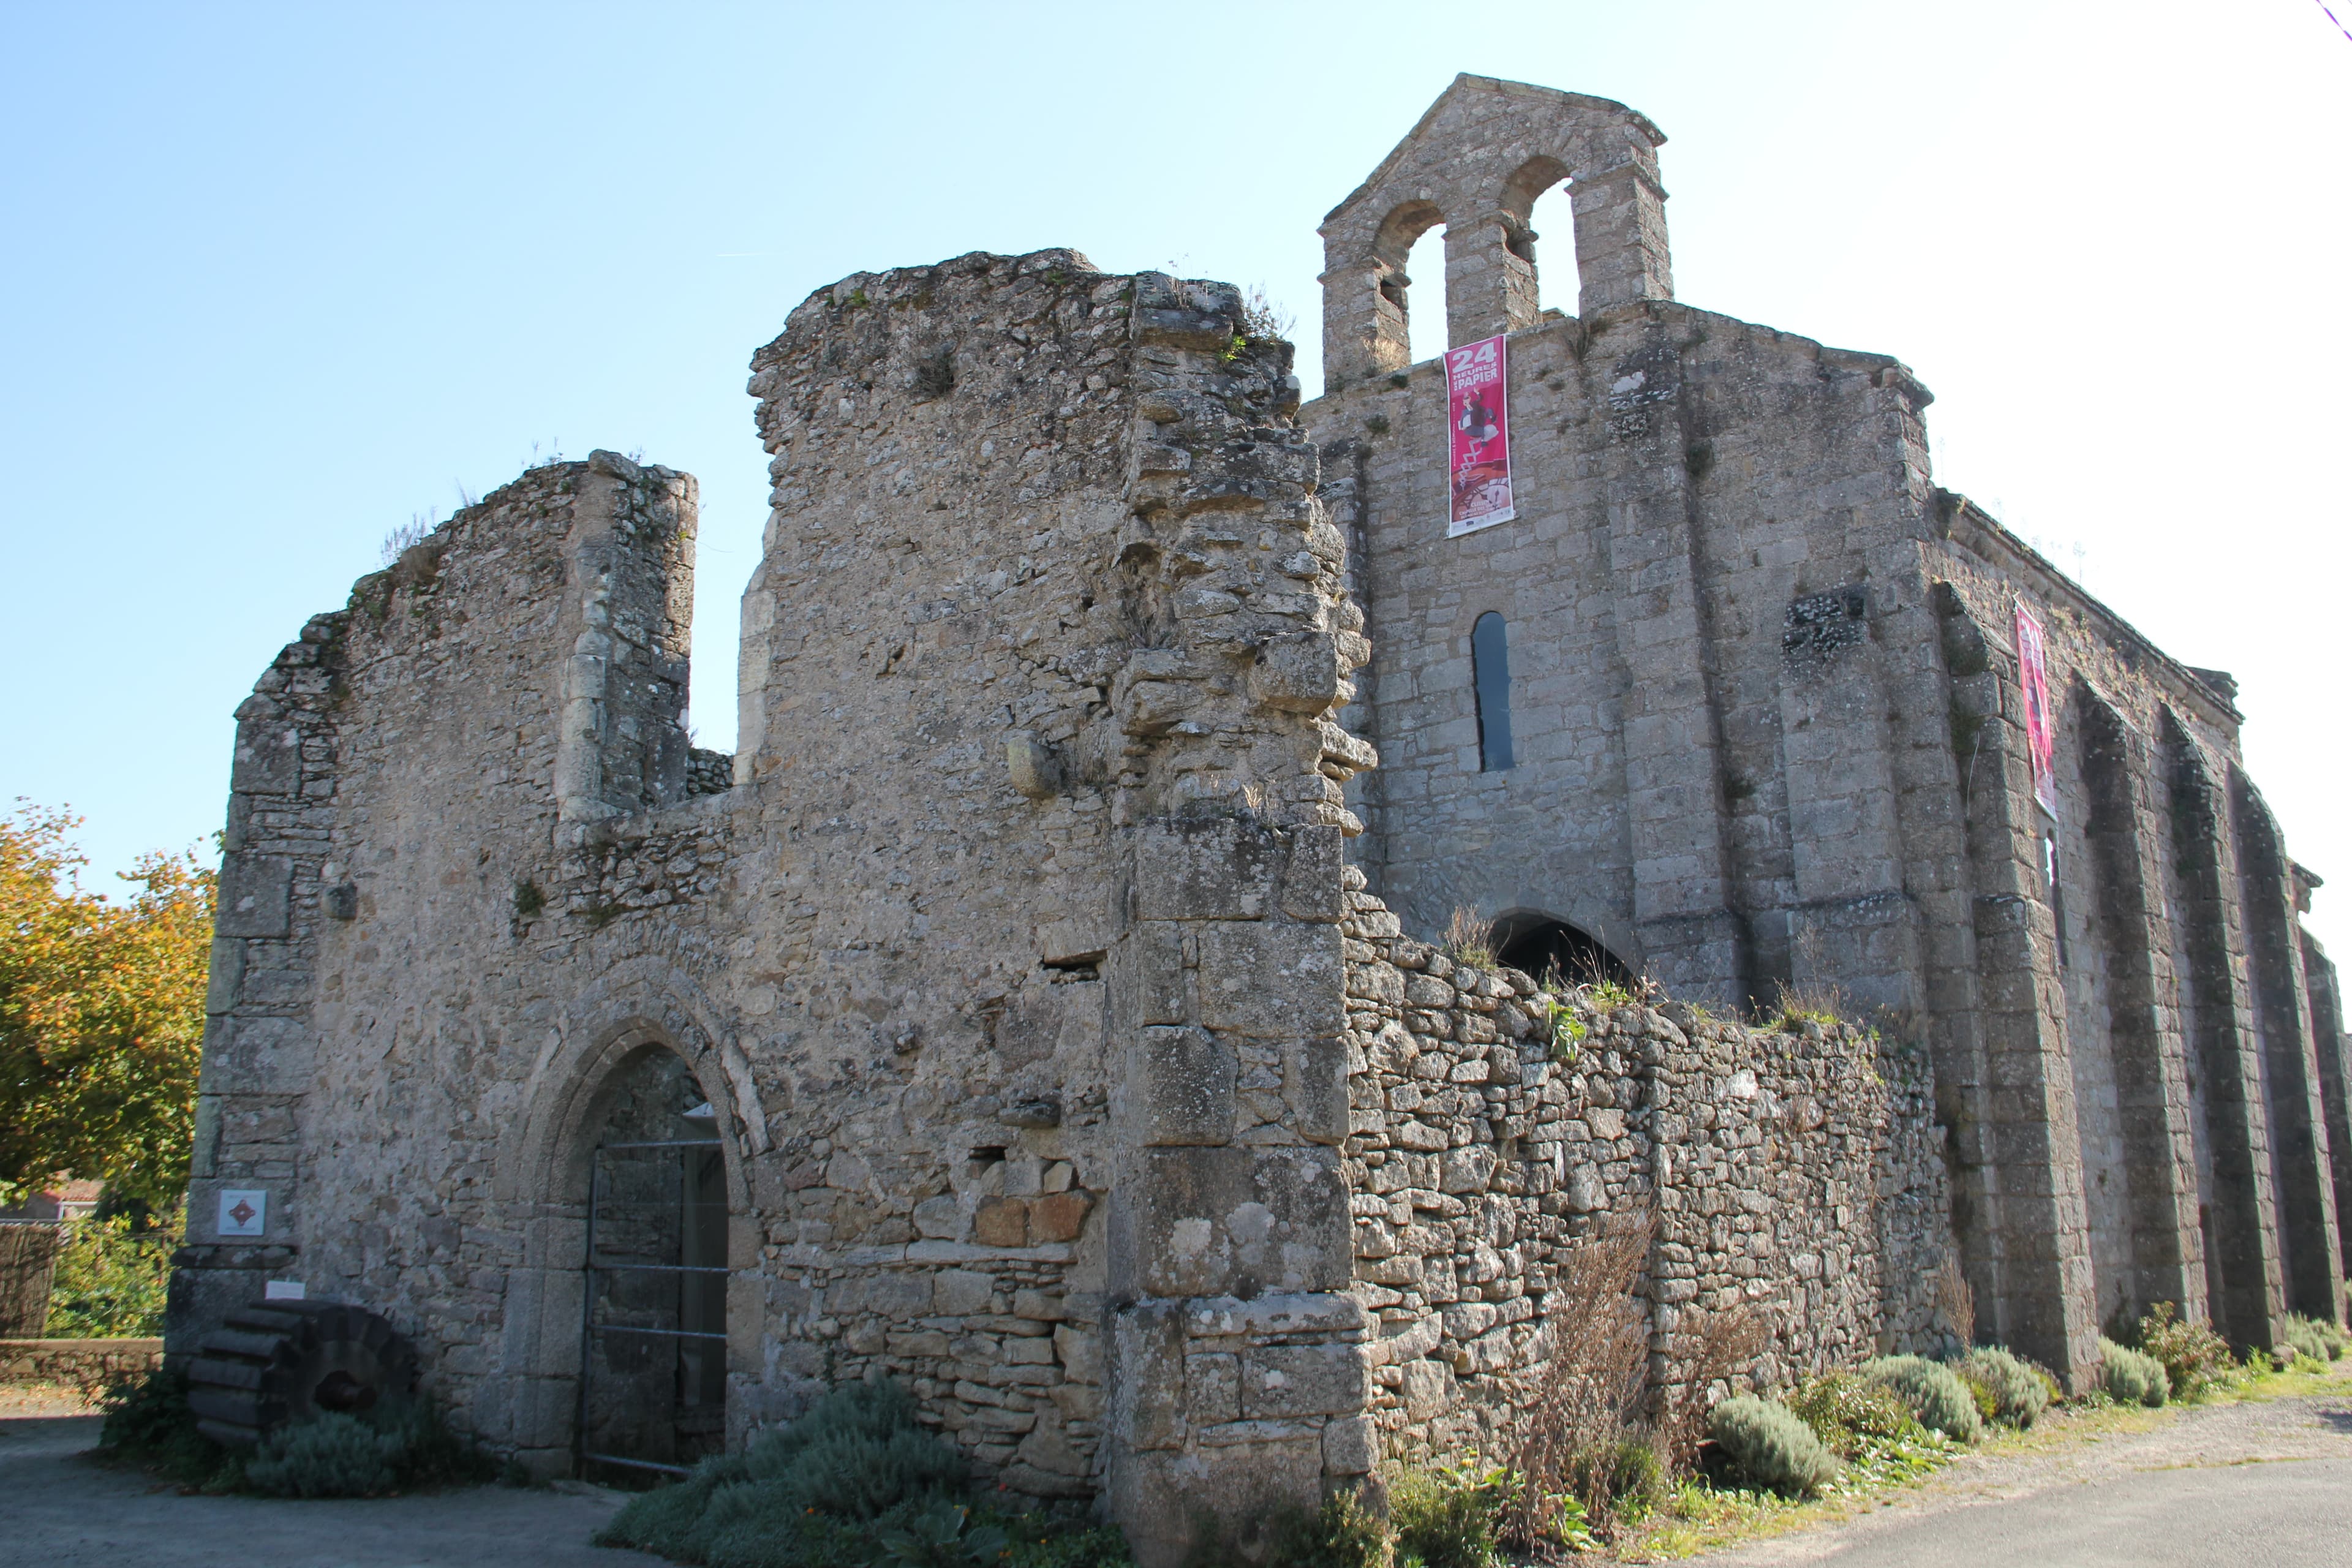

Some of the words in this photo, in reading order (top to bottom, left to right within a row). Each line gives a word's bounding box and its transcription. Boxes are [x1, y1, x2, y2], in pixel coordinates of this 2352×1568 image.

[1452, 342, 1497, 374] 24
[1453, 361, 1497, 380] HEURES
[1458, 368, 1498, 390] PAPIER
